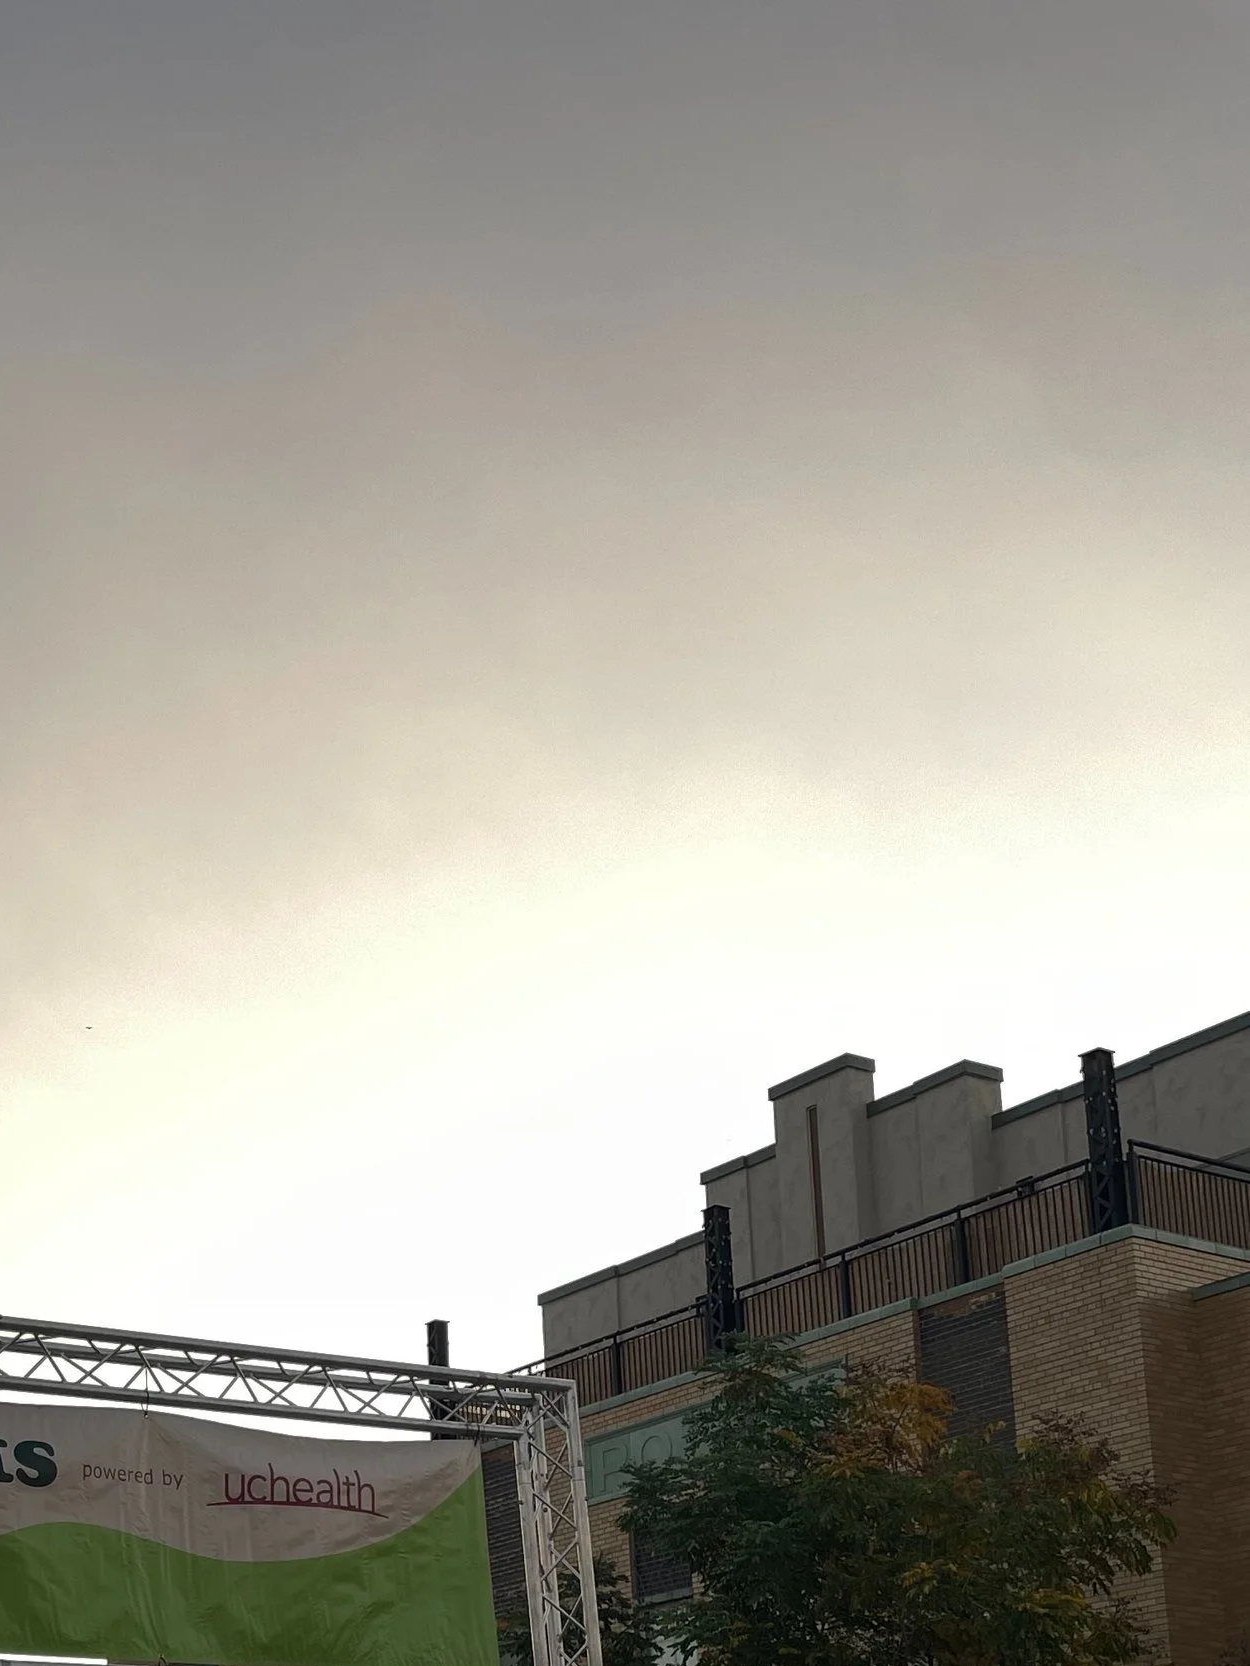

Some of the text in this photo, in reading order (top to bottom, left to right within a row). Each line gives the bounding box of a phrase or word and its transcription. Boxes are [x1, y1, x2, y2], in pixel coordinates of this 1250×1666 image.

[82, 1463, 185, 1491] powered by
[223, 1462, 377, 1514] uchealth
